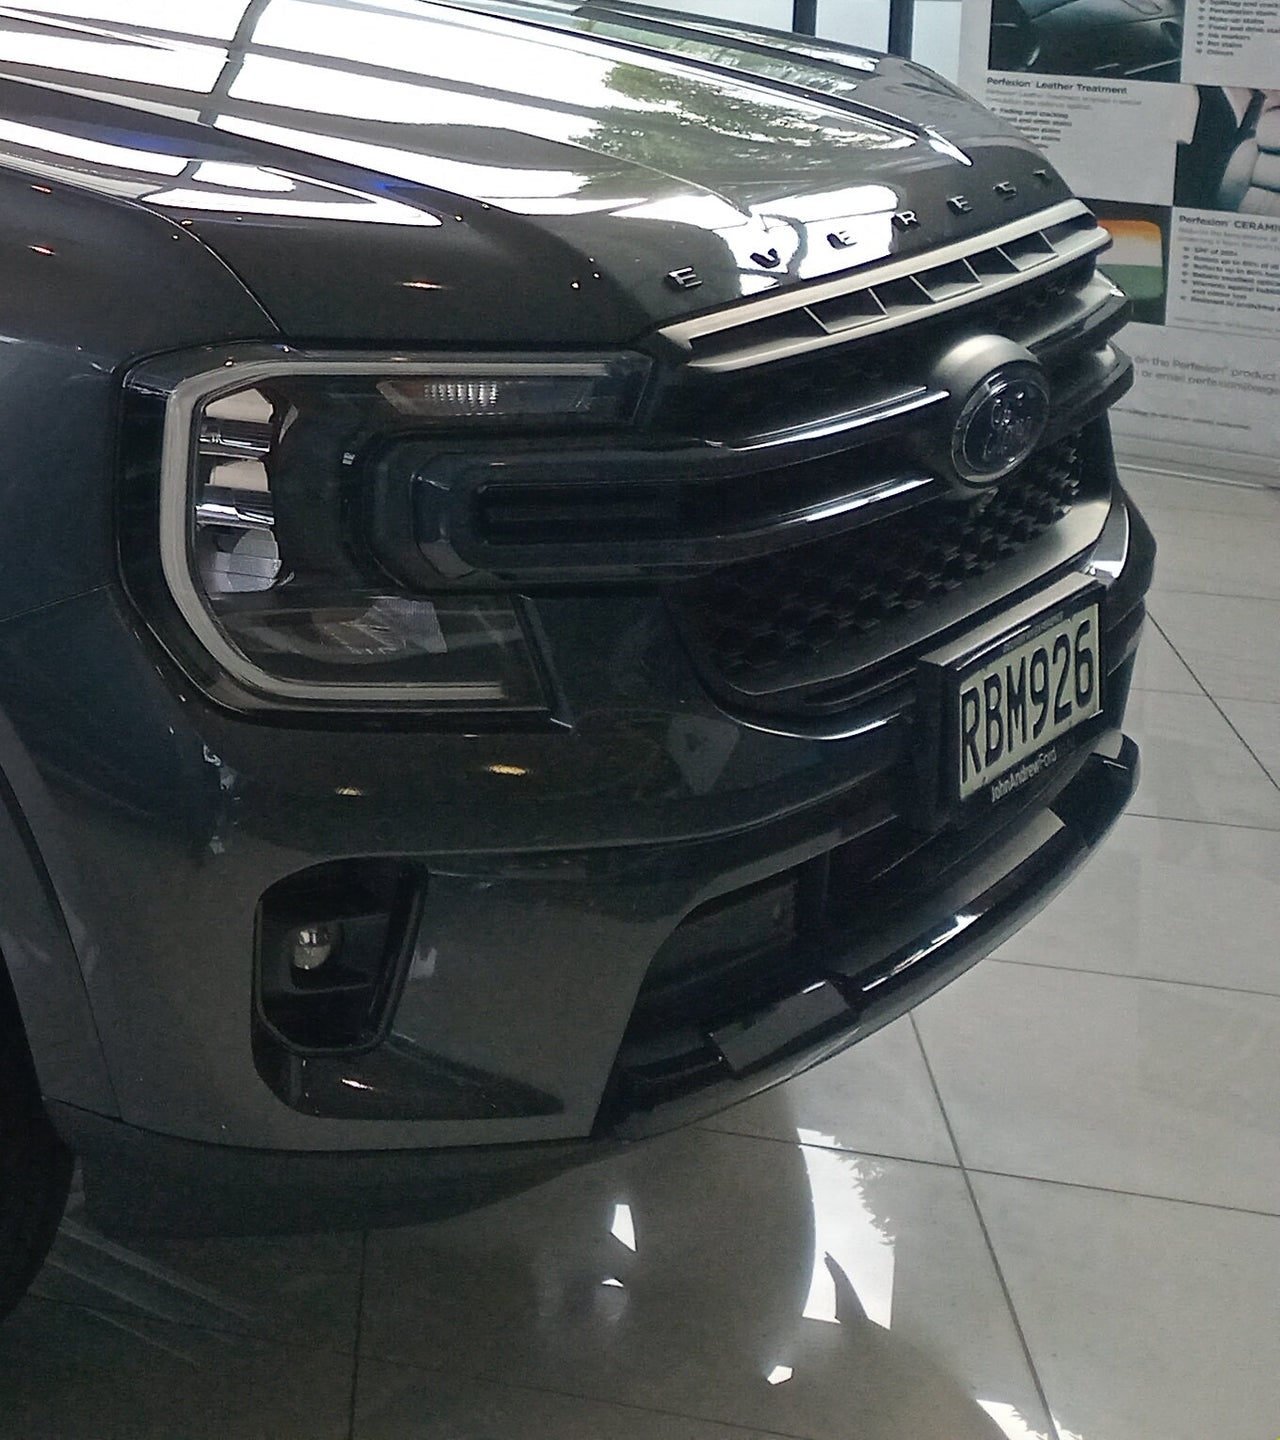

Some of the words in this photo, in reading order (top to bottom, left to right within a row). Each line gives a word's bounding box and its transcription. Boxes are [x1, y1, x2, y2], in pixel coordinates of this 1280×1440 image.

[987, 77, 1030, 87] Perfexion
[1036, 81, 1073, 91] Leather
[1077, 83, 1127, 94] Treatment
[665, 167, 1052, 292] EVEREST
[1231, 365, 1276, 380] product
[959, 619, 1094, 782] RBM926
